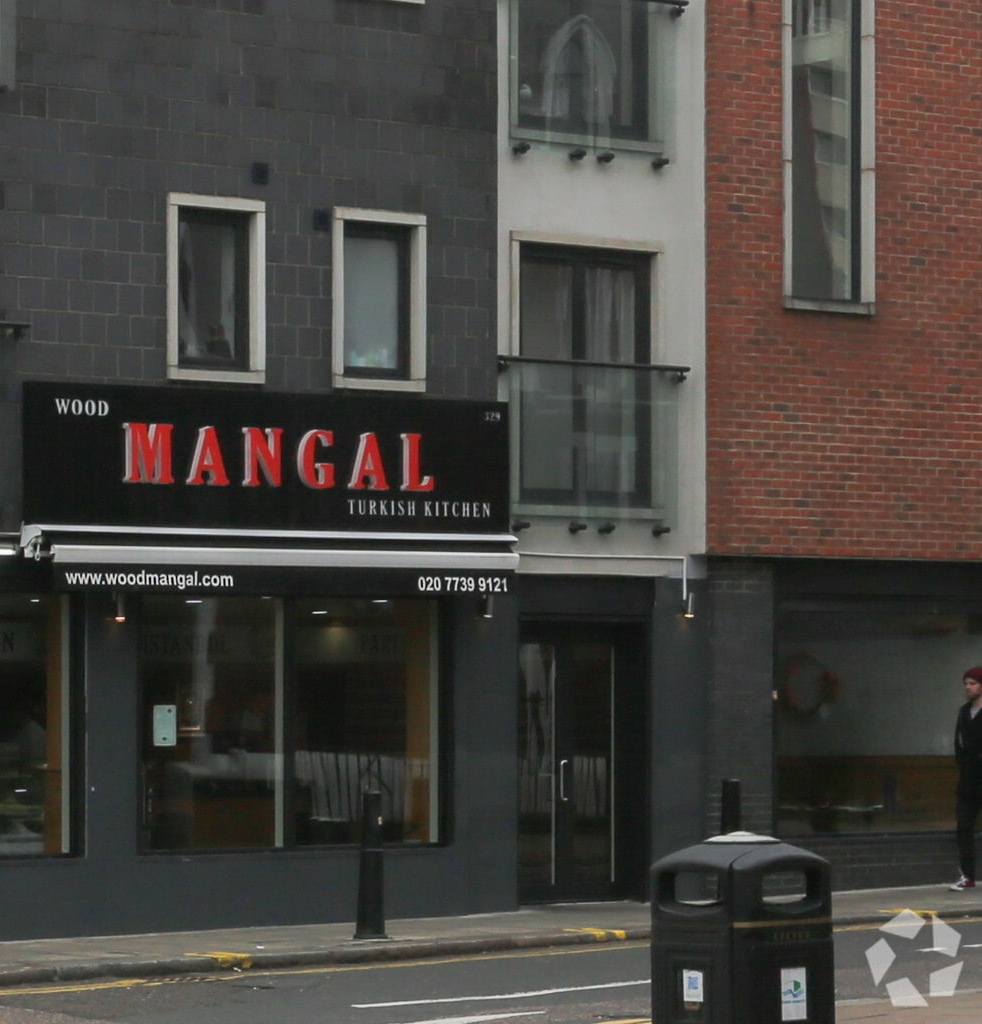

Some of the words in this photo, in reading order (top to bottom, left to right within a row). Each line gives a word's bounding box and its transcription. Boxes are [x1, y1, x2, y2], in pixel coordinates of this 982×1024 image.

[55, 398, 109, 417] WOOD
[483, 411, 501, 422] 329
[122, 422, 434, 492] MANGAL
[348, 499, 416, 517] TURKISH
[424, 501, 491, 518] KITCHEN
[65, 569, 234, 590] www.woodmangal.com
[418, 577, 442, 592] 020
[444, 577, 473, 593] 7739
[475, 578, 508, 593] 9121
